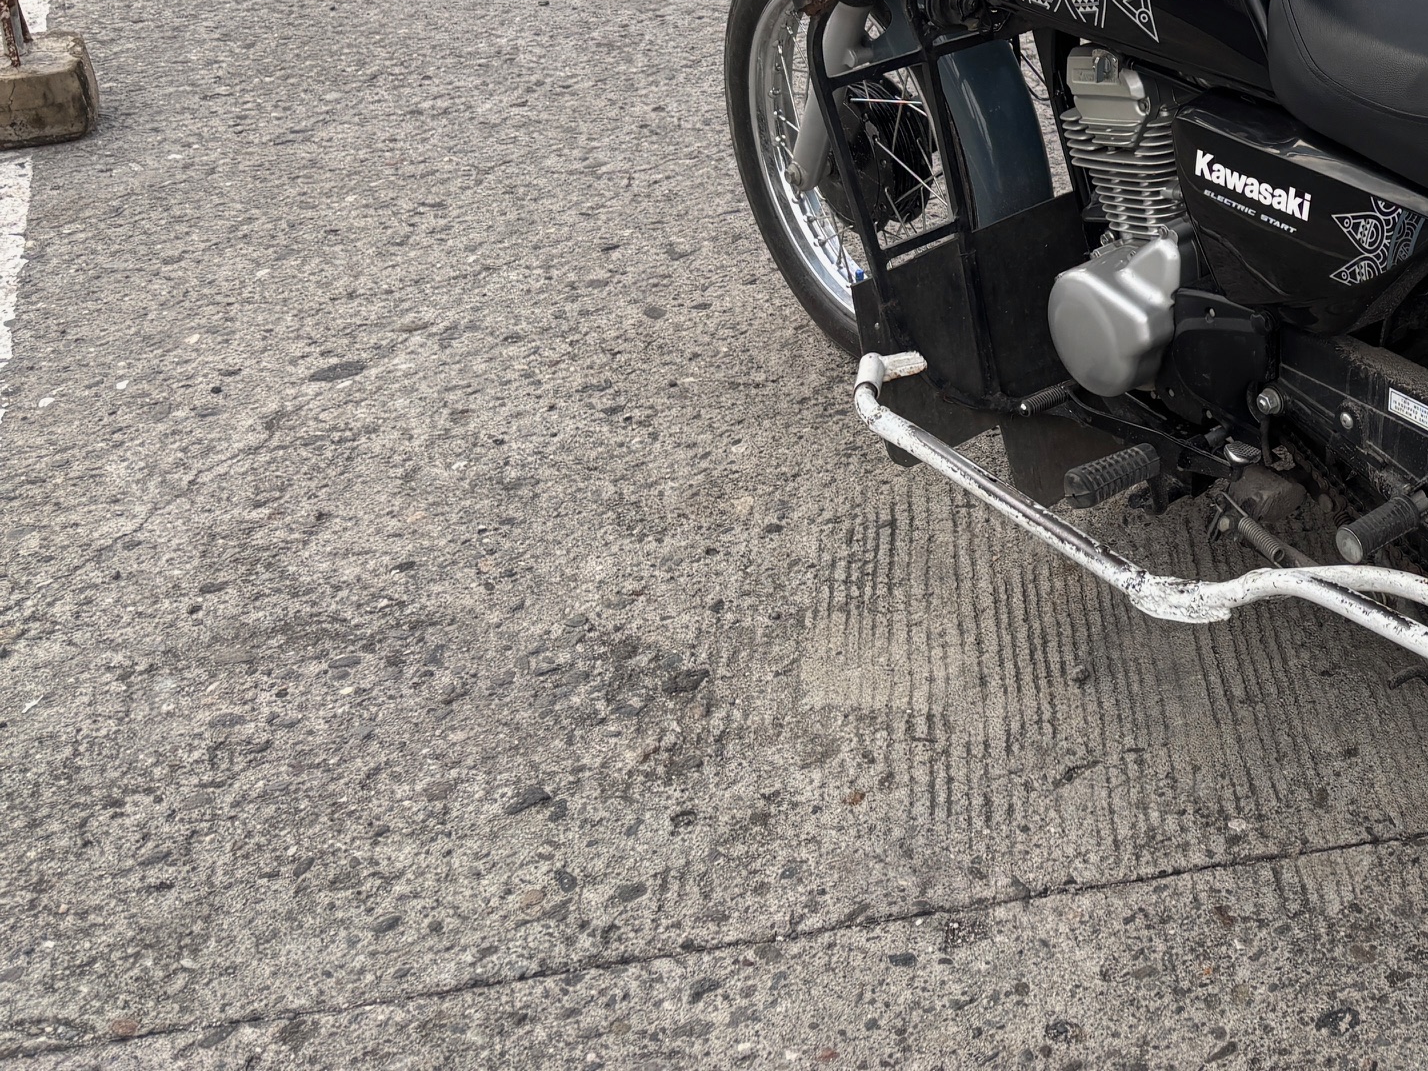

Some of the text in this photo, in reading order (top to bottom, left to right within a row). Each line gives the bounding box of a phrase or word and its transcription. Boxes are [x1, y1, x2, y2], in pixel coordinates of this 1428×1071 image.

[1195, 149, 1312, 222] Kawasaki
[1203, 189, 1297, 234] ELECTRIC START
